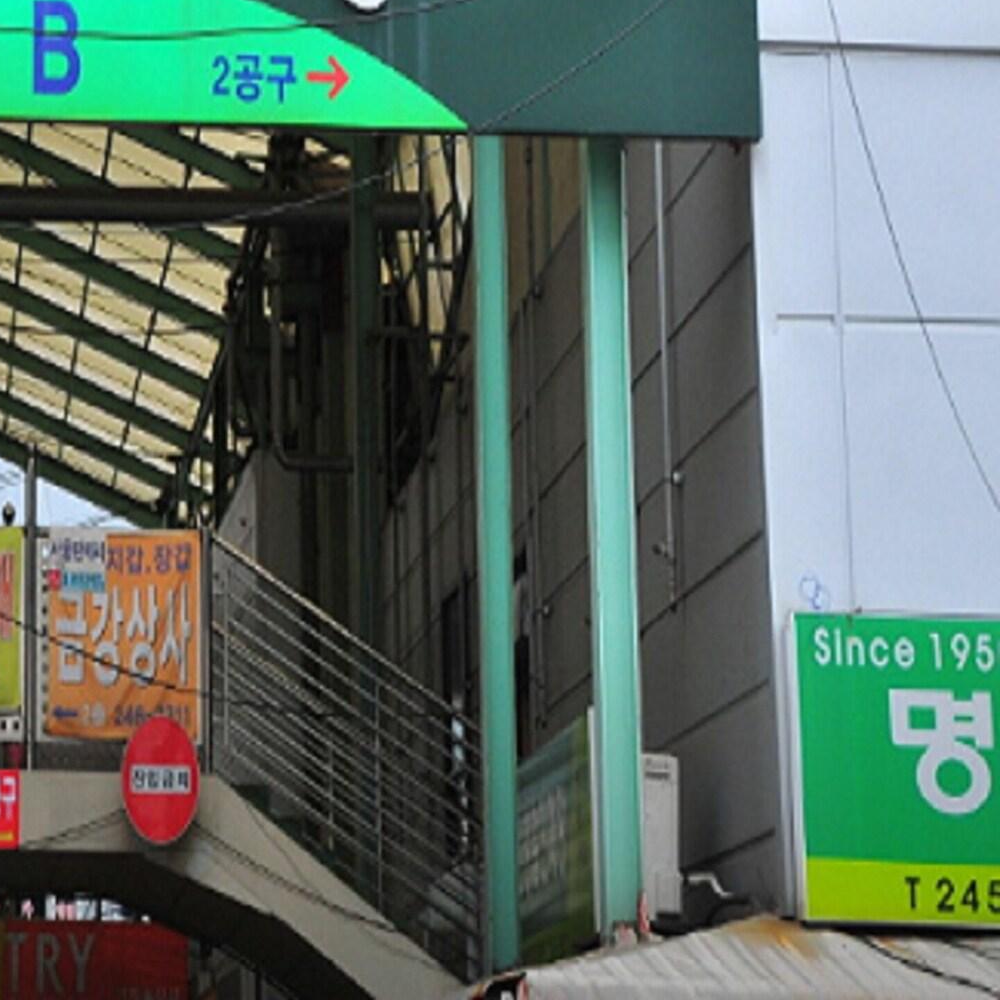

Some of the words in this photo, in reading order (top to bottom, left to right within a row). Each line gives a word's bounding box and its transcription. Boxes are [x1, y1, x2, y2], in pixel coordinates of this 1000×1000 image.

[31, 0, 81, 96] B
[212, 53, 298, 104] 2공구
[54, 582, 192, 689] 금강상사
[928, 631, 1000, 672] 195
[887, 687, 996, 816] 명
[904, 875, 921, 911] T
[936, 876, 1000, 914] 245
[7, 929, 98, 993] TRY
